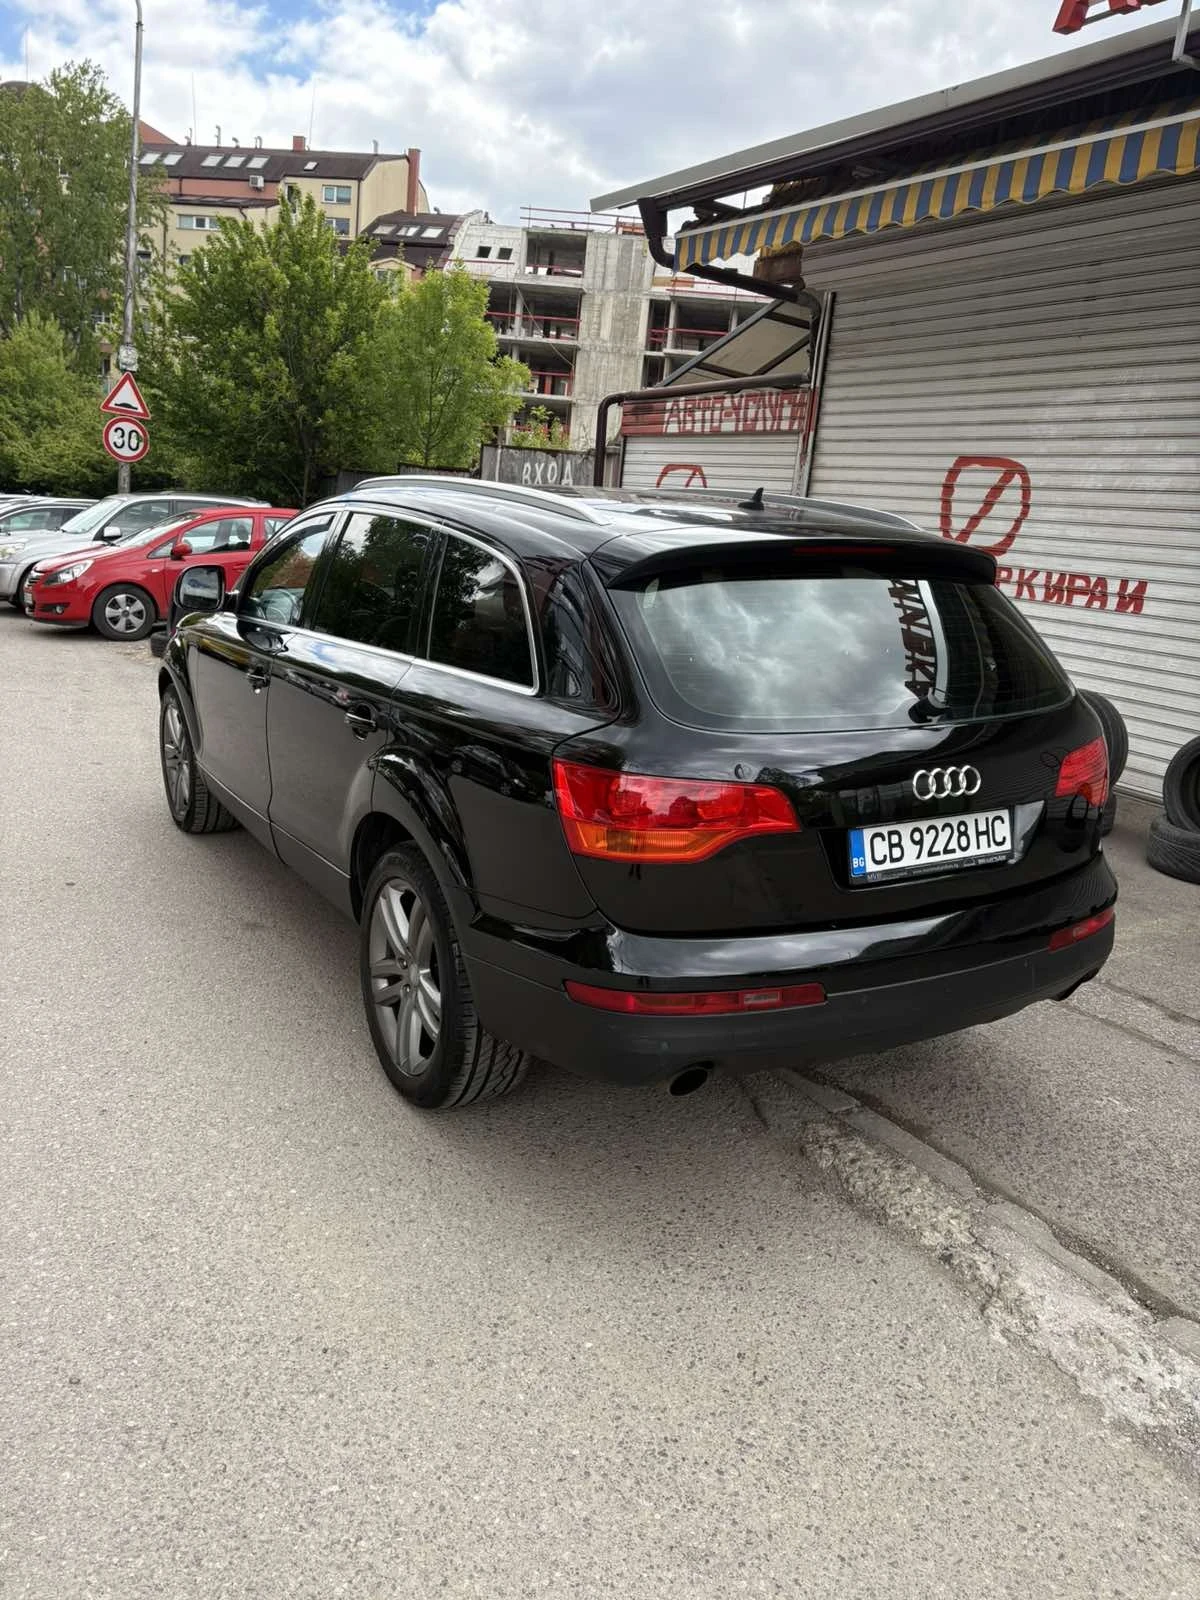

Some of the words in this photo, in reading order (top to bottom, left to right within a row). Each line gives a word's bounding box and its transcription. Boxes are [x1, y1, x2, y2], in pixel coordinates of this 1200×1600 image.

[113, 427, 140, 451] 30
[522, 460, 573, 486] ВХОД
[870, 830, 904, 865] CB
[910, 820, 970, 859] 9228
[975, 815, 1006, 849] HC
[853, 857, 864, 867] BG
